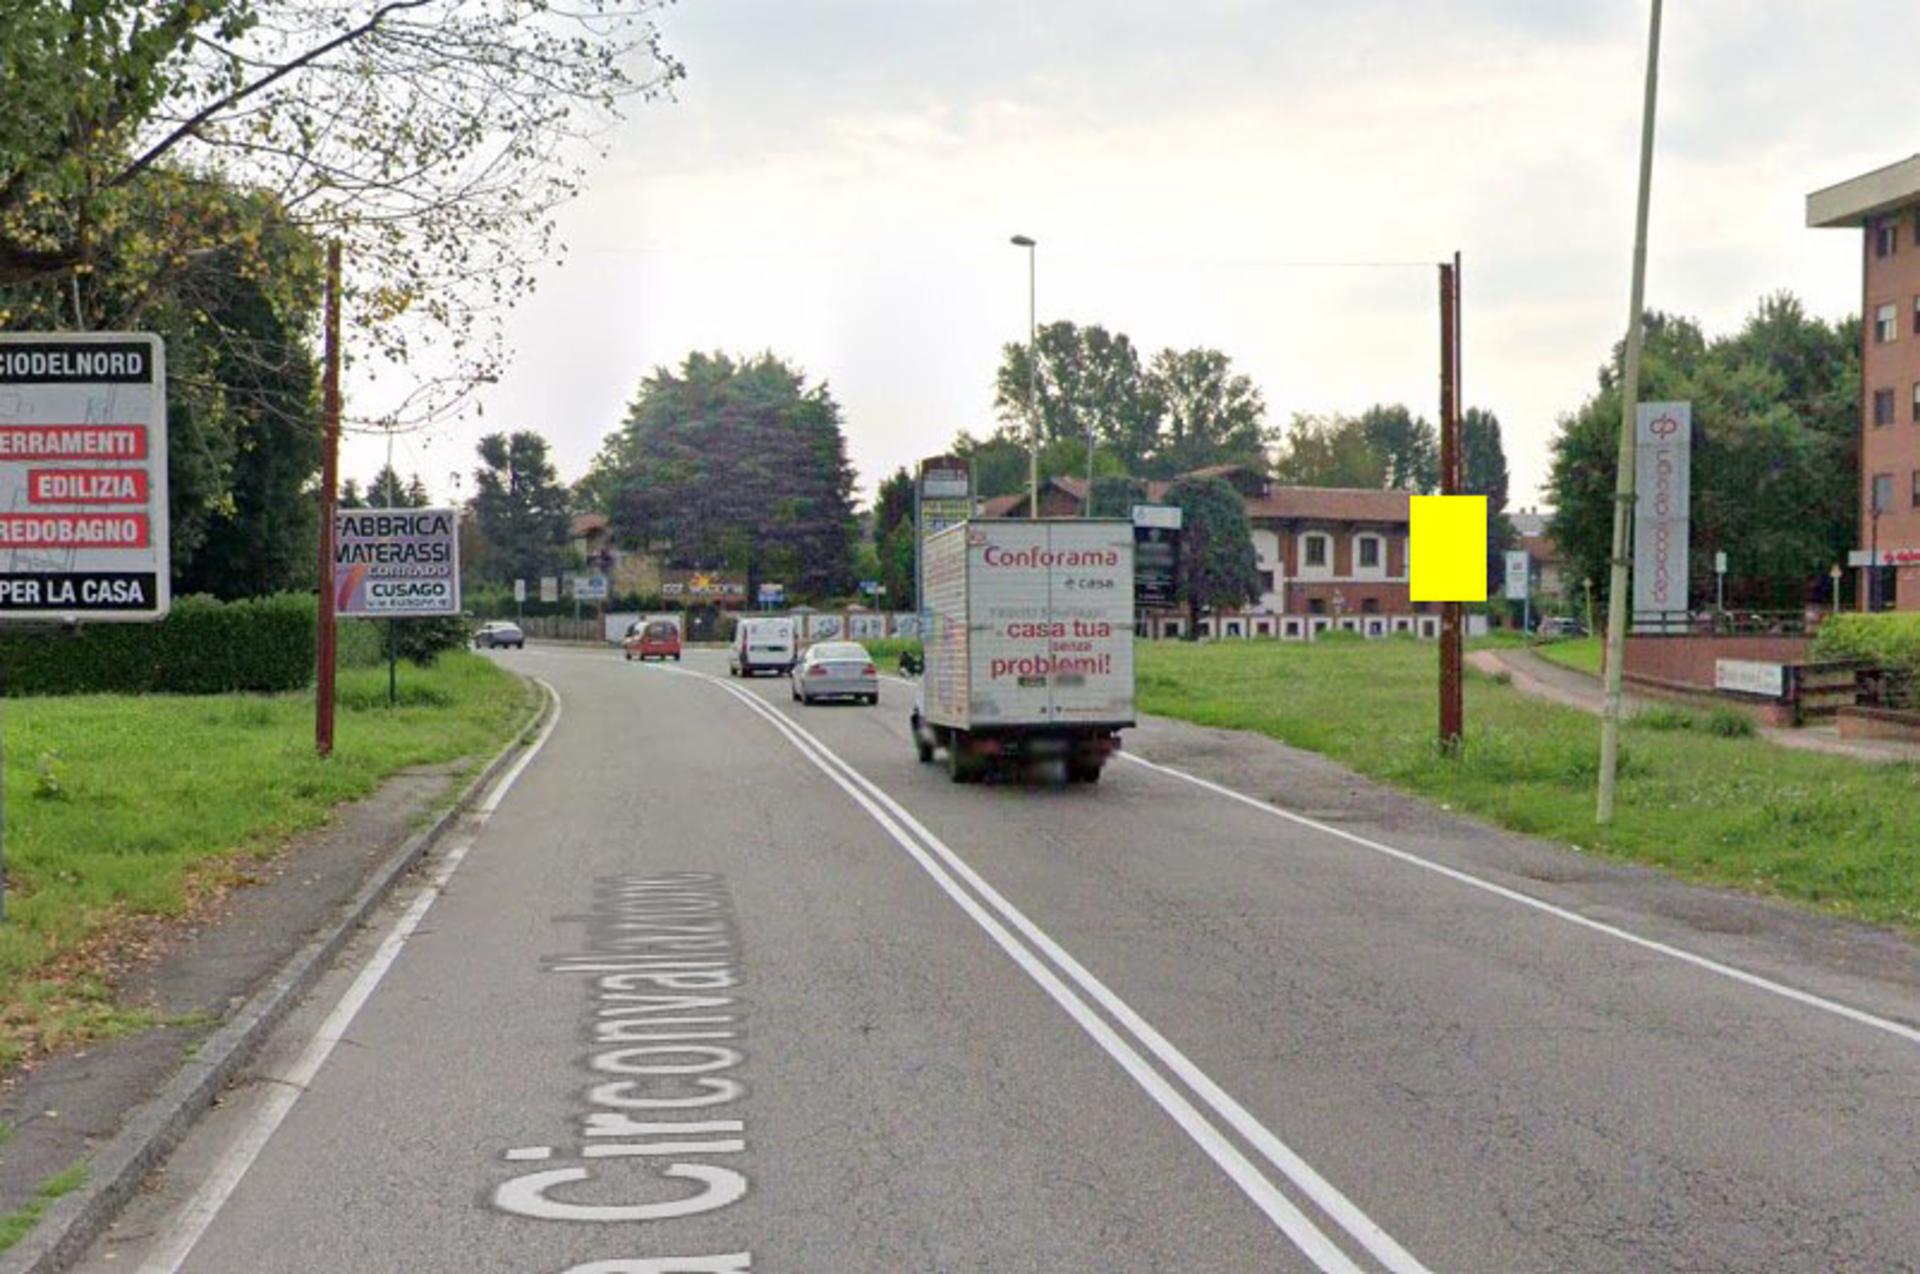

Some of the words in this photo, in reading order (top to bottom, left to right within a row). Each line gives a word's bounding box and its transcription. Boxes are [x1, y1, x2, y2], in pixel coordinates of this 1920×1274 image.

[0, 431, 135, 453] ERRAMENTI
[38, 476, 136, 497] EDILIZIA
[984, 545, 1119, 568] Conforama
[0, 580, 40, 602] PER
[47, 580, 76, 602] LA
[82, 580, 144, 603] CASA
[372, 583, 446, 597] CUSAGO
[1079, 578, 1114, 589] casa
[1007, 622, 1066, 638] casa
[1073, 619, 1111, 638] tua
[992, 654, 1111, 679] problemi!
